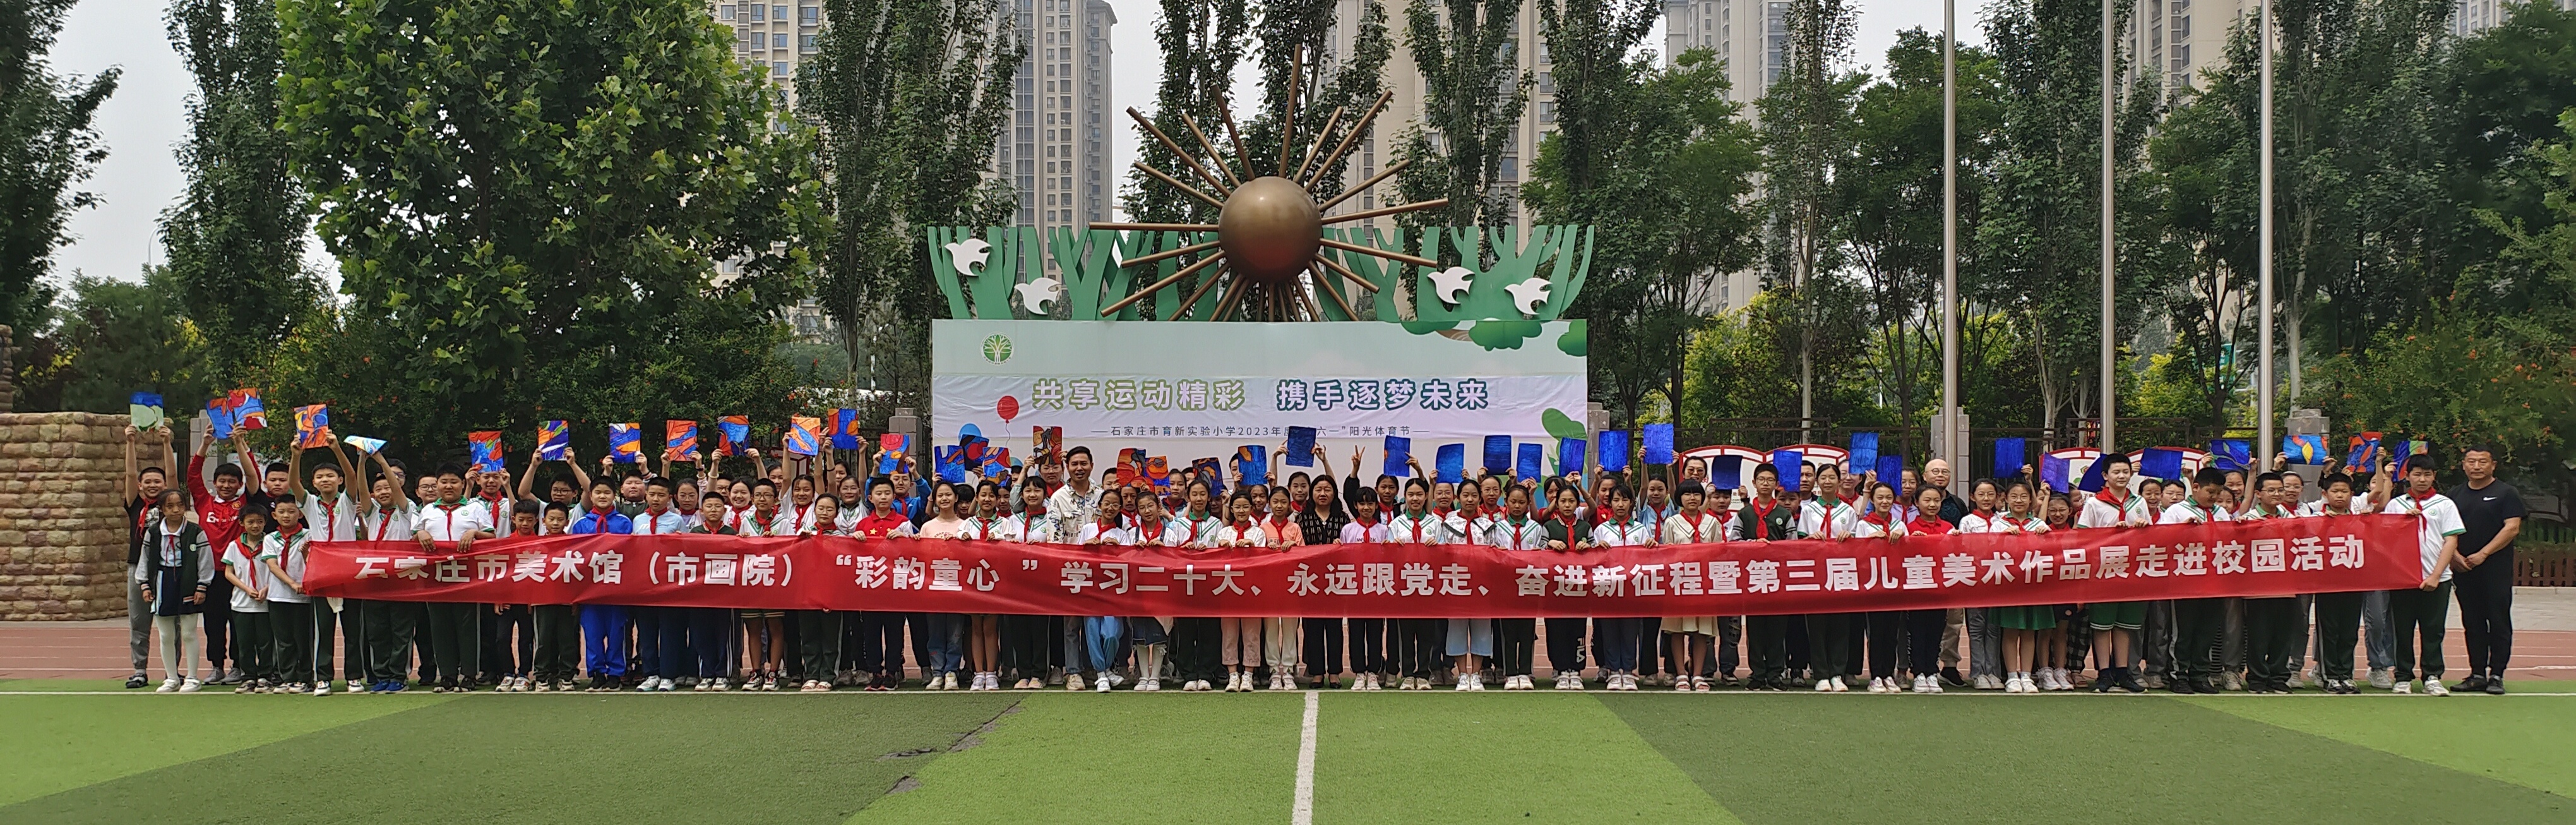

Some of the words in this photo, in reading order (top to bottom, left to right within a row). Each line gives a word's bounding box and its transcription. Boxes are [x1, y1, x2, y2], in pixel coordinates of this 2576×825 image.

[1032, 378, 1246, 411] 共享运动精彩
[1276, 379, 1488, 411] 携手逐梦未来
[1111, 426, 1410, 437] 石家庄市育新实验小学2023年六一”阳光体育节
[1577, 637, 1585, 663] FILA
